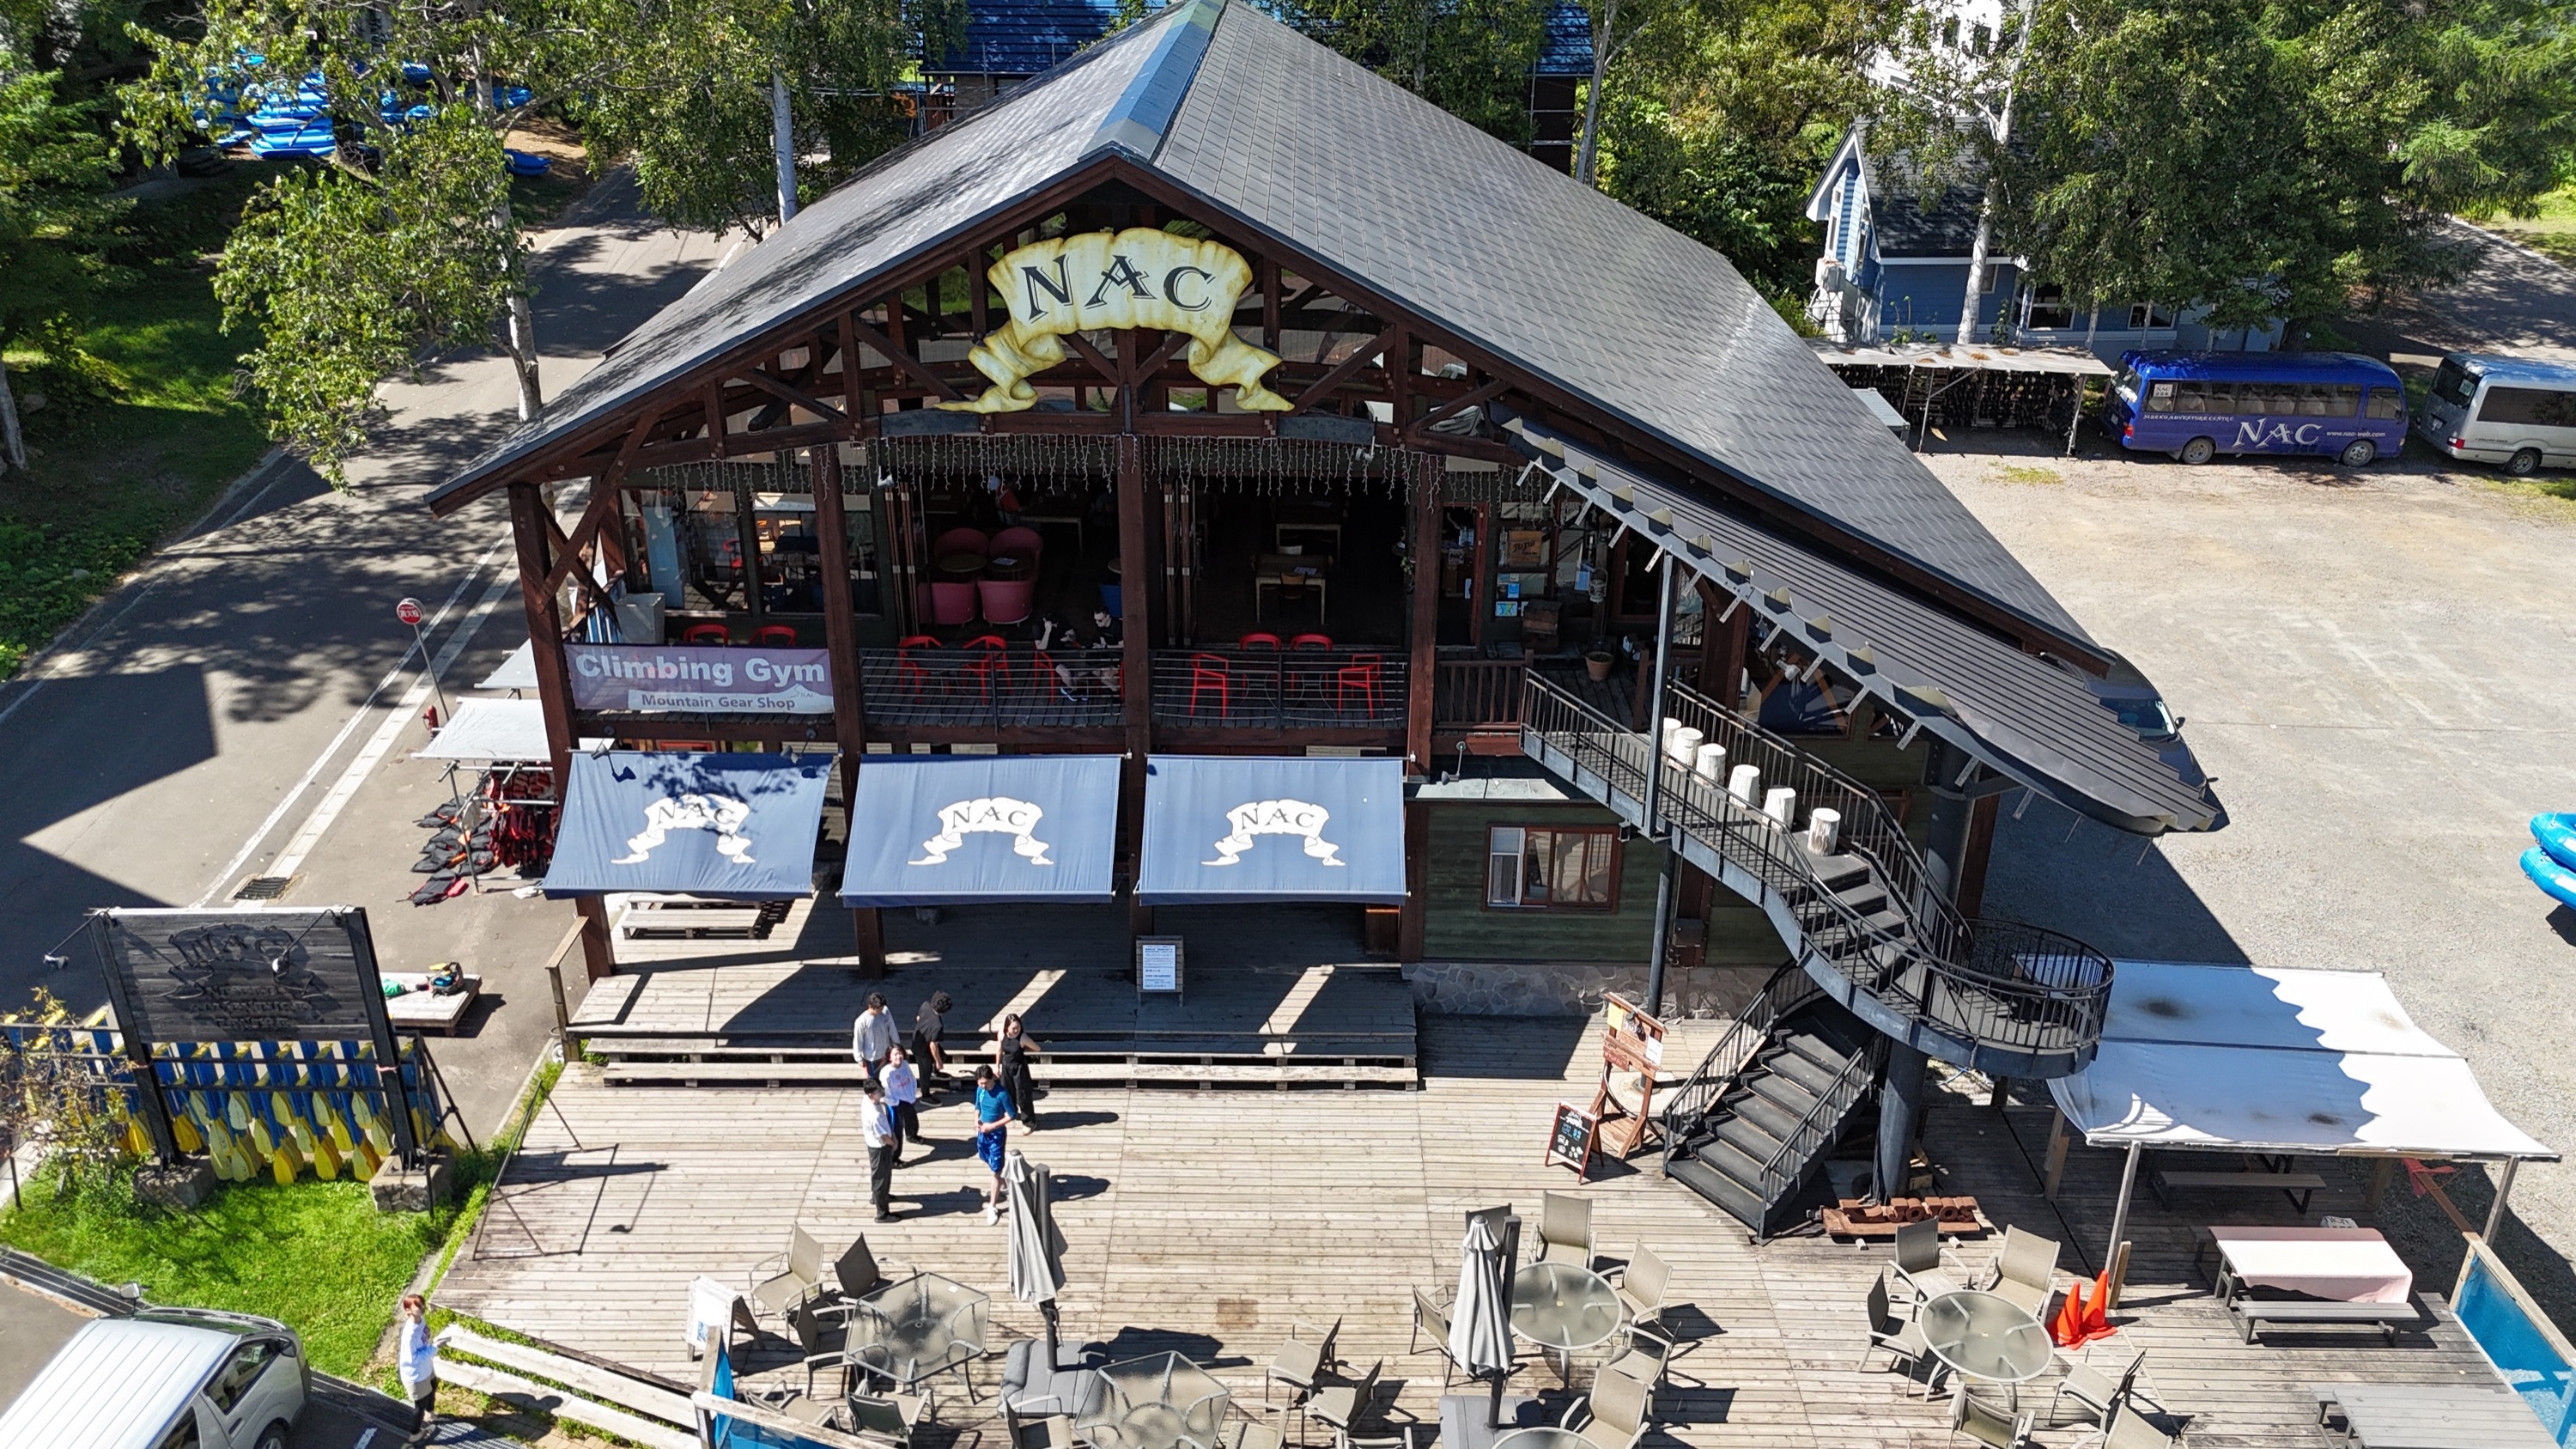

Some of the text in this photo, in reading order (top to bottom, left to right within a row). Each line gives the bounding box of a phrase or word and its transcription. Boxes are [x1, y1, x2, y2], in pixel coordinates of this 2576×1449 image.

[1021, 253, 1216, 324] NAC
[2232, 417, 2322, 448] NAC
[575, 654, 824, 687] Climbing Gym
[641, 694, 795, 711] Mountain Gear Shop
[658, 802, 736, 825] NAC
[951, 806, 1028, 829] NAC
[1242, 808, 1315, 831] NAC
